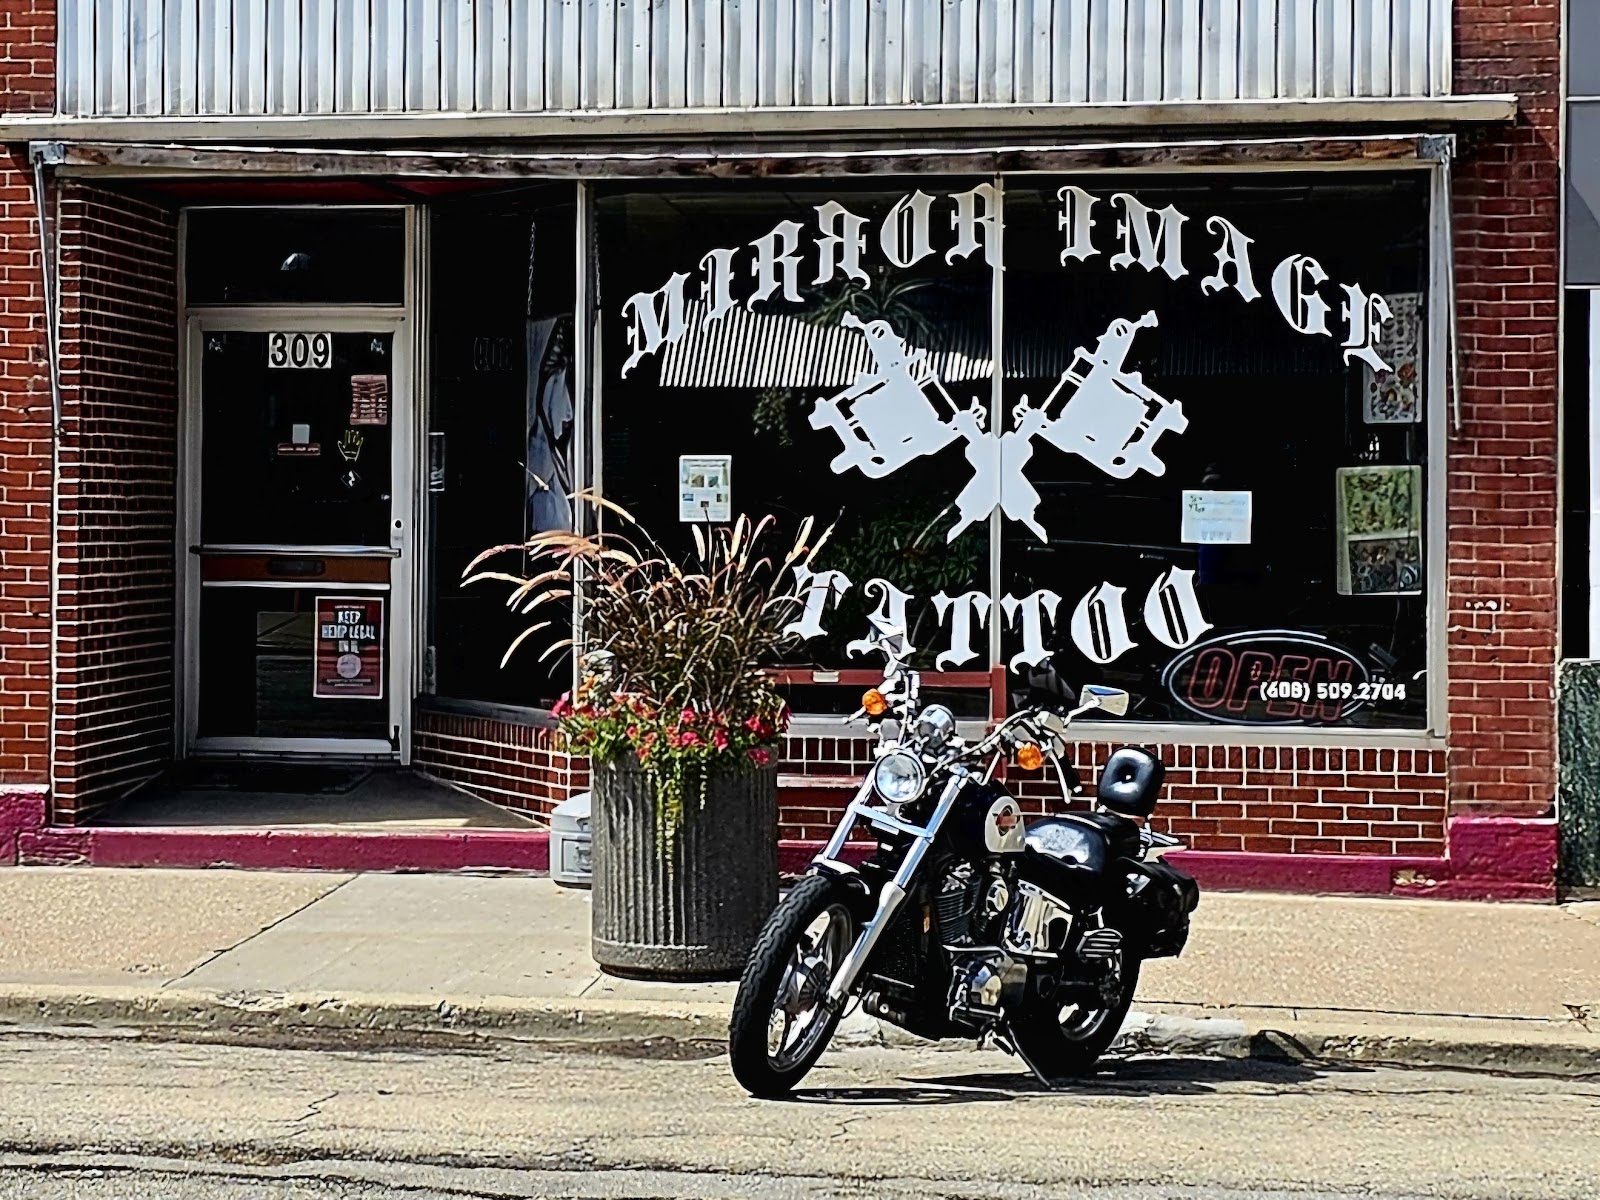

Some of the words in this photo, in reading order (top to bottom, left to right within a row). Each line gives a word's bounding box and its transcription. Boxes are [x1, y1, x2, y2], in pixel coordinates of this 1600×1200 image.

[621, 182, 1006, 379] MIRROR
[1057, 185, 1395, 373] IMAGE
[270, 332, 330, 368] 309
[782, 565, 1214, 675] TATTOO
[1189, 648, 1353, 720] OPEN
[1260, 681, 1310, 702] (608)
